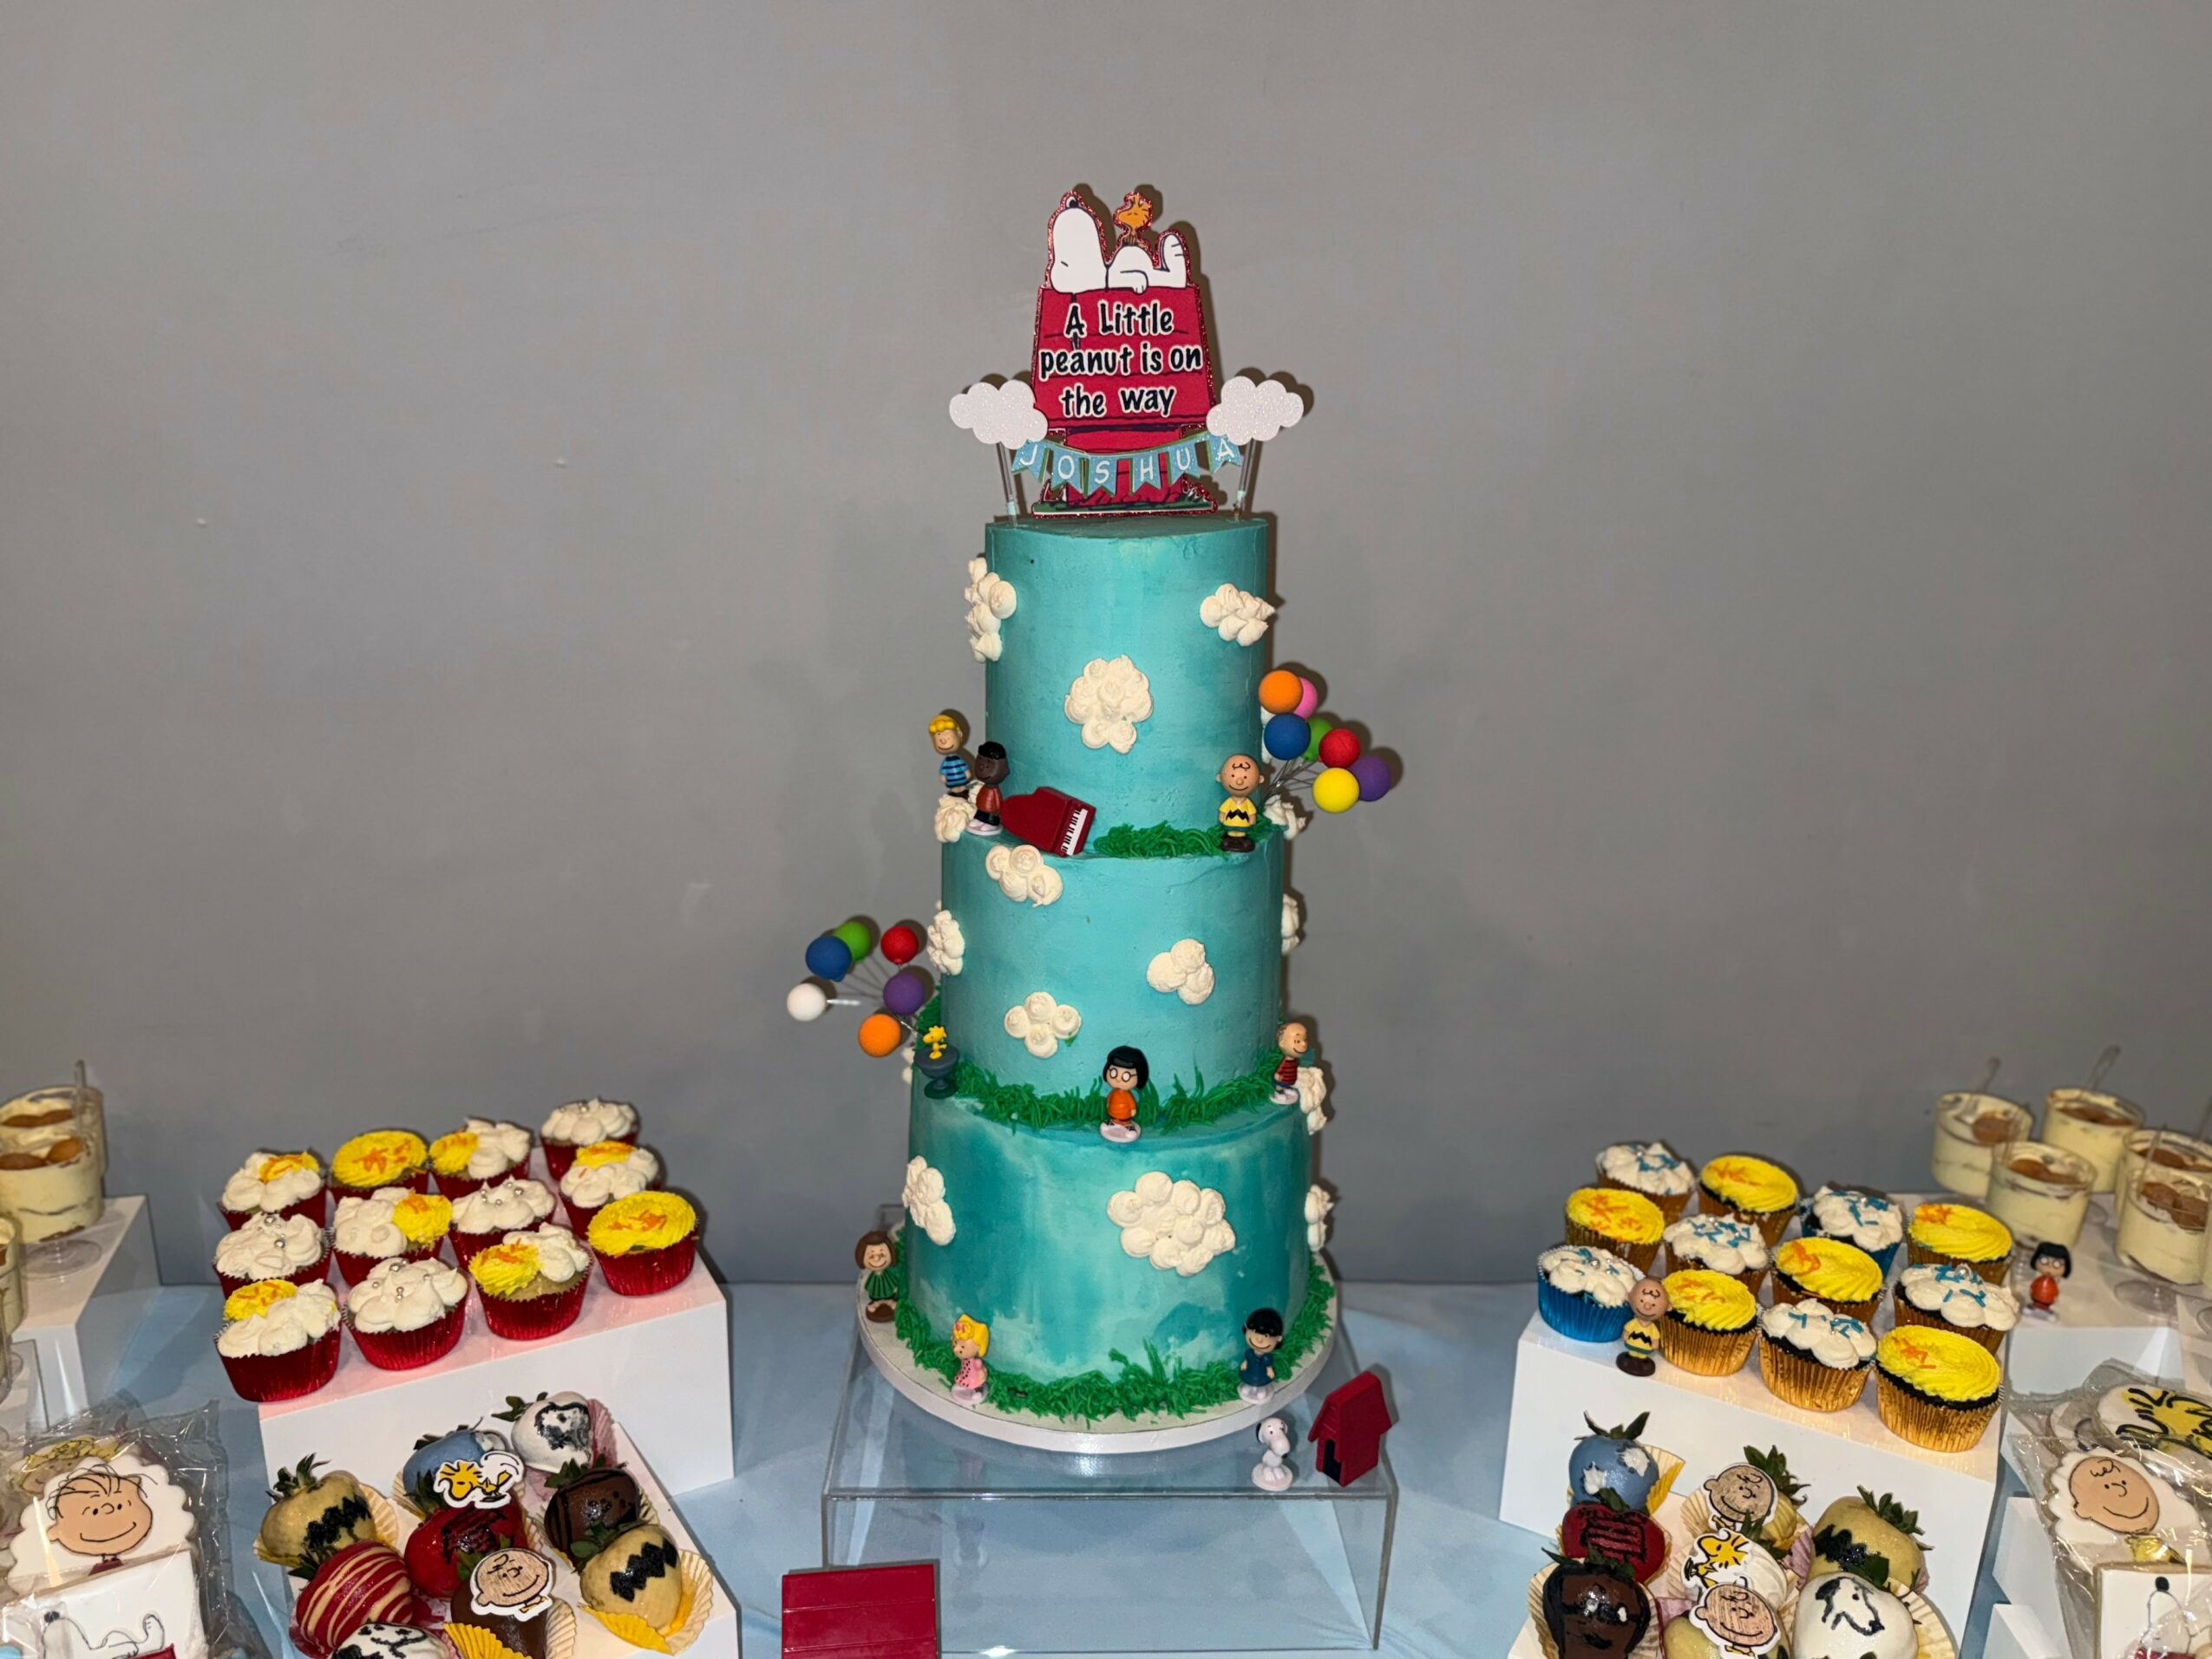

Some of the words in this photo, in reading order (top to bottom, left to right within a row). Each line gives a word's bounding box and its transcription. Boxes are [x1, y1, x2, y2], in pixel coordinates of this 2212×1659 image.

[1065, 305, 1086, 336] A
[1100, 303, 1174, 335] Little
[1040, 345, 1132, 380] peanut
[1142, 344, 1162, 372] is
[1170, 346, 1202, 370] on
[1061, 386, 1105, 416] the
[1120, 389, 1175, 415] way
[1020, 441, 1234, 485] JOSHUA
